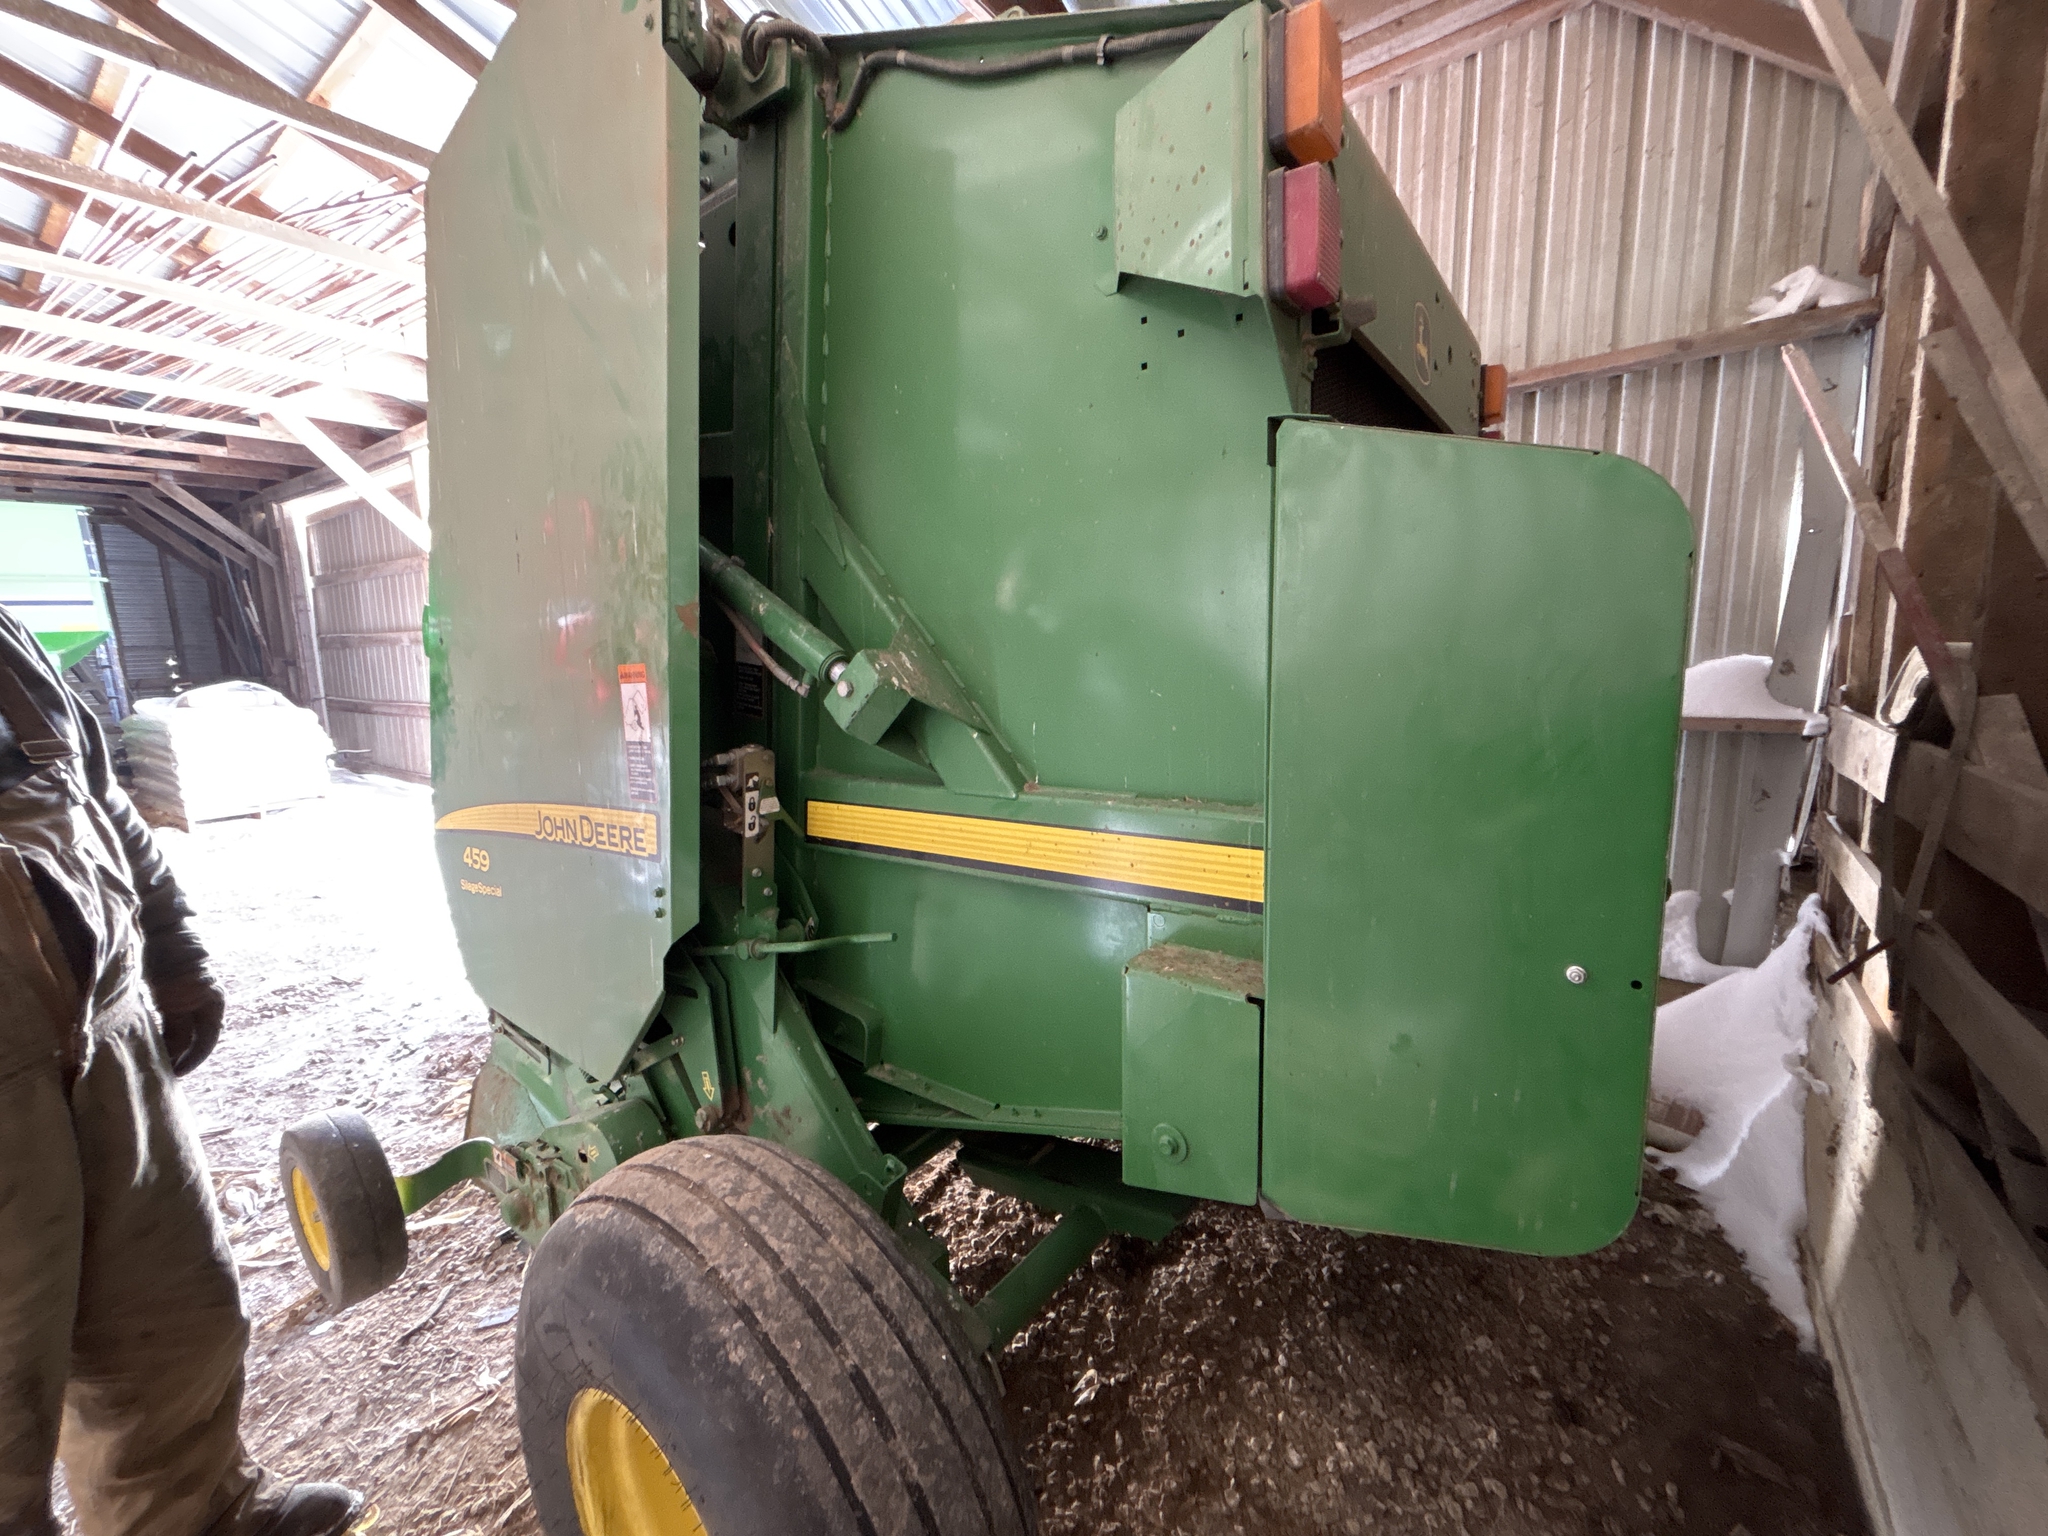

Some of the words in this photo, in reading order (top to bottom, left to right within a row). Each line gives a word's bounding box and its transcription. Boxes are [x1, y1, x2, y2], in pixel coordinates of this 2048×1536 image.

[535, 810, 578, 842] JOHN
[579, 814, 648, 855] DEERE
[462, 846, 490, 872] 459
